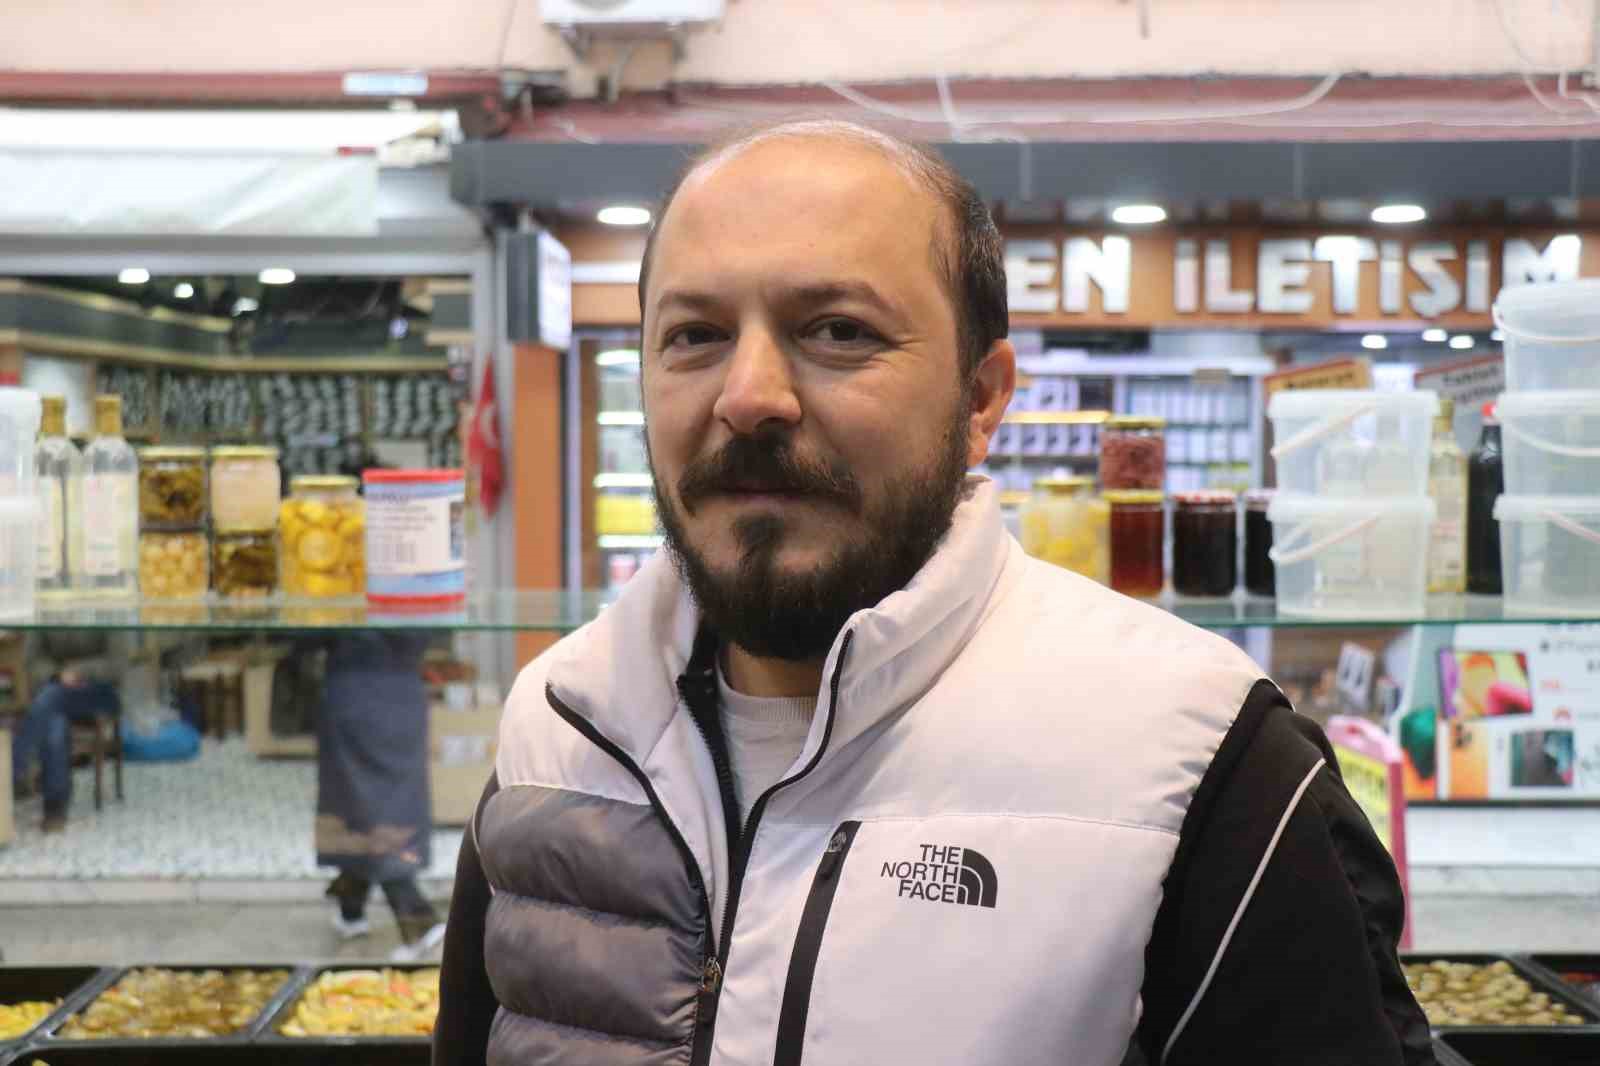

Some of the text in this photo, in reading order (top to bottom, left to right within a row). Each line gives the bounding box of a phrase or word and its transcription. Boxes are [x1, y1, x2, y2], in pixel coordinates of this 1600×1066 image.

[919, 844, 962, 865] THE
[880, 861, 959, 884] NORTH
[898, 879, 956, 903] FACE
